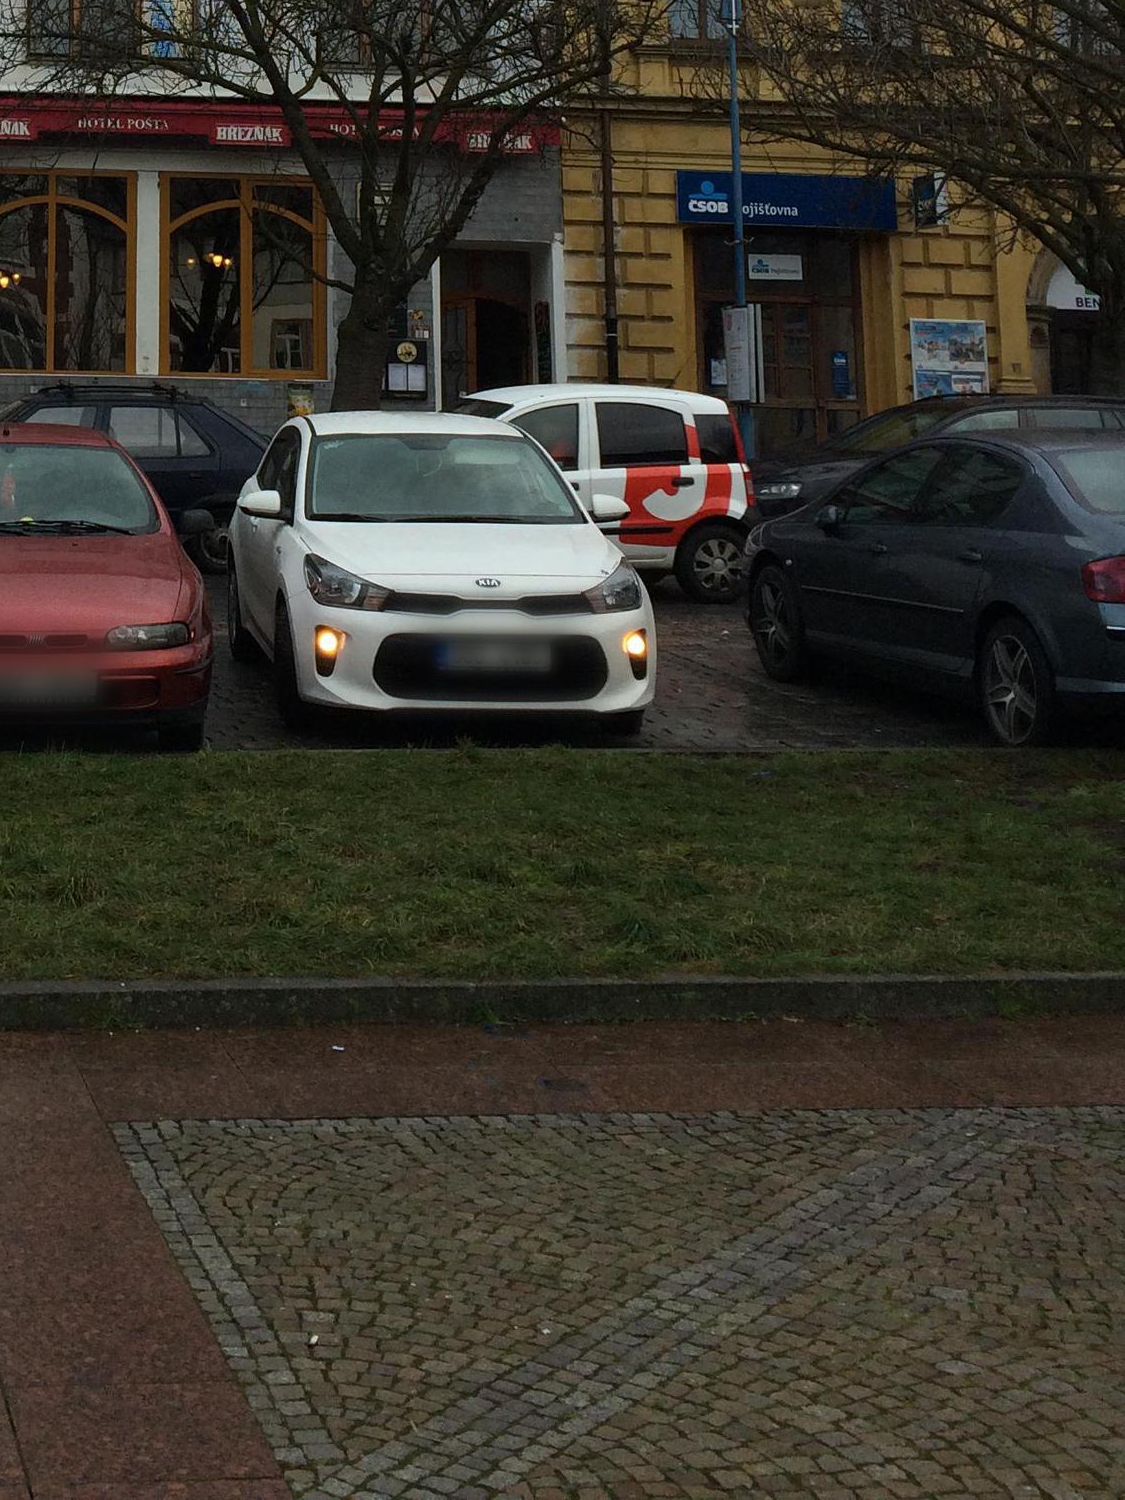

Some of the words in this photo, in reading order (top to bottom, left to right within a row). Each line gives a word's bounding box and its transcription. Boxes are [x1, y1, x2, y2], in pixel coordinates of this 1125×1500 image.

[78, 116, 124, 129] HOTEL
[127, 116, 169, 130] POŠTA
[688, 199, 729, 213] ČSOB
[741, 202, 799, 218] ojišťovna
[477, 579, 500, 587] KIA
